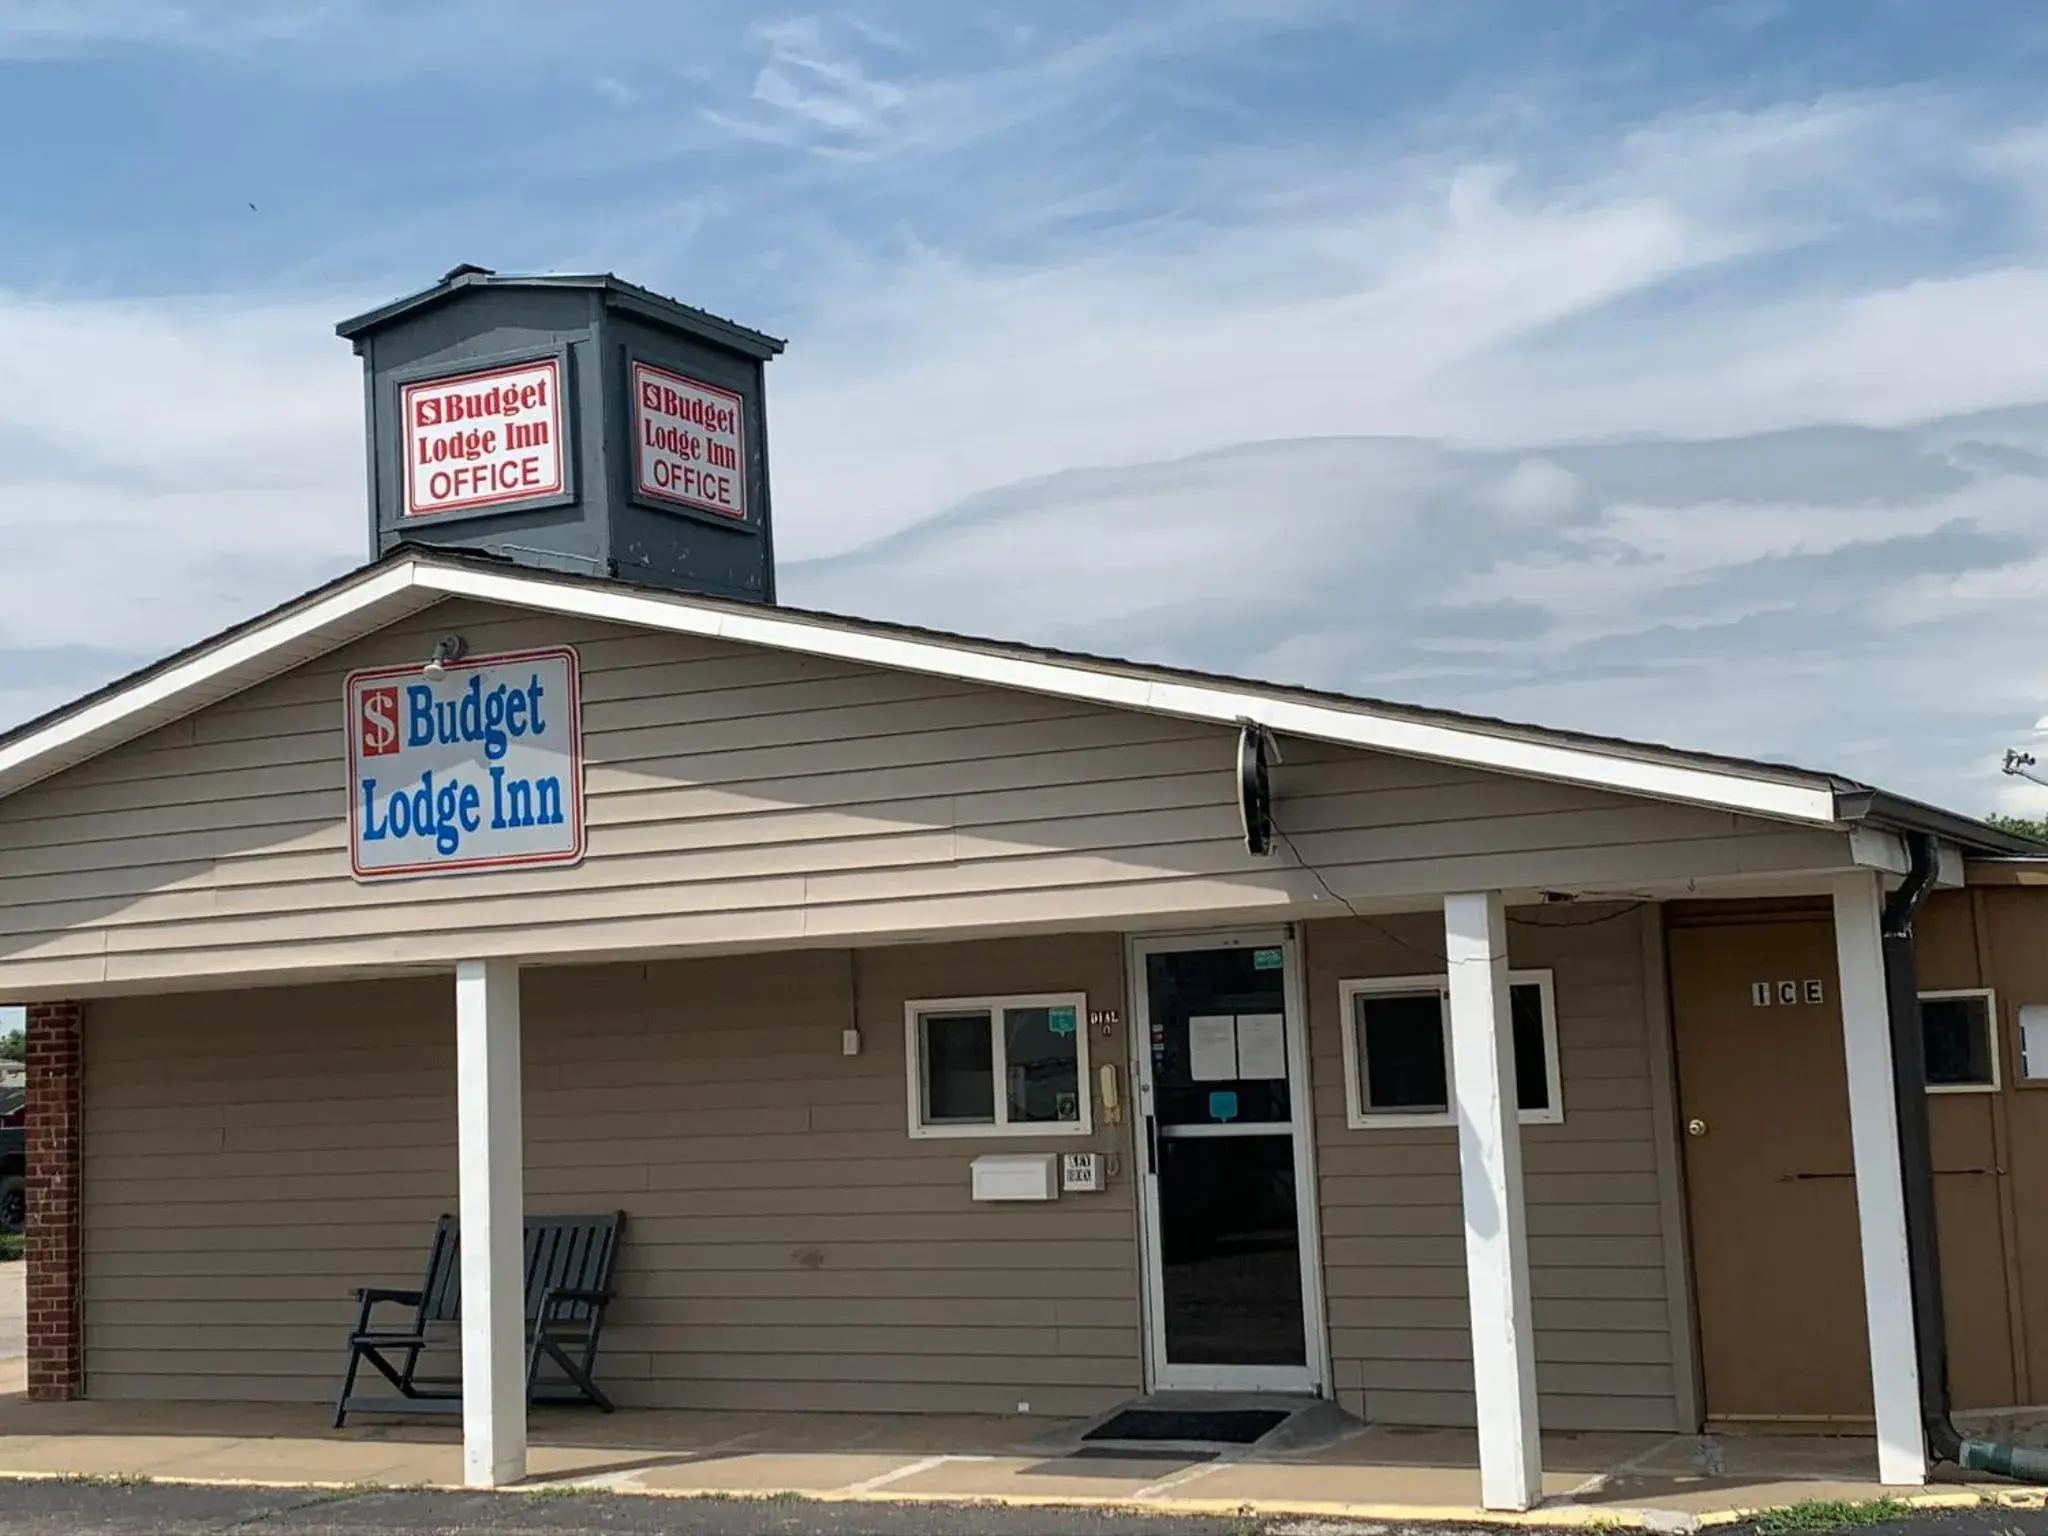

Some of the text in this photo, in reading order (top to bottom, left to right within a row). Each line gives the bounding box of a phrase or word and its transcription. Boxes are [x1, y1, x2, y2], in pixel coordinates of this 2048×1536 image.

[444, 378, 547, 423] Budget
[664, 387, 735, 435] Budget
[418, 421, 549, 465] Lodge Inn
[644, 418, 736, 470] Lodge Inn
[429, 456, 541, 499] OFFICE
[653, 459, 731, 504] OFFICE
[406, 674, 546, 760] Budget
[362, 766, 563, 855] Lodge Inn
[1757, 981, 1821, 1004] ICE
